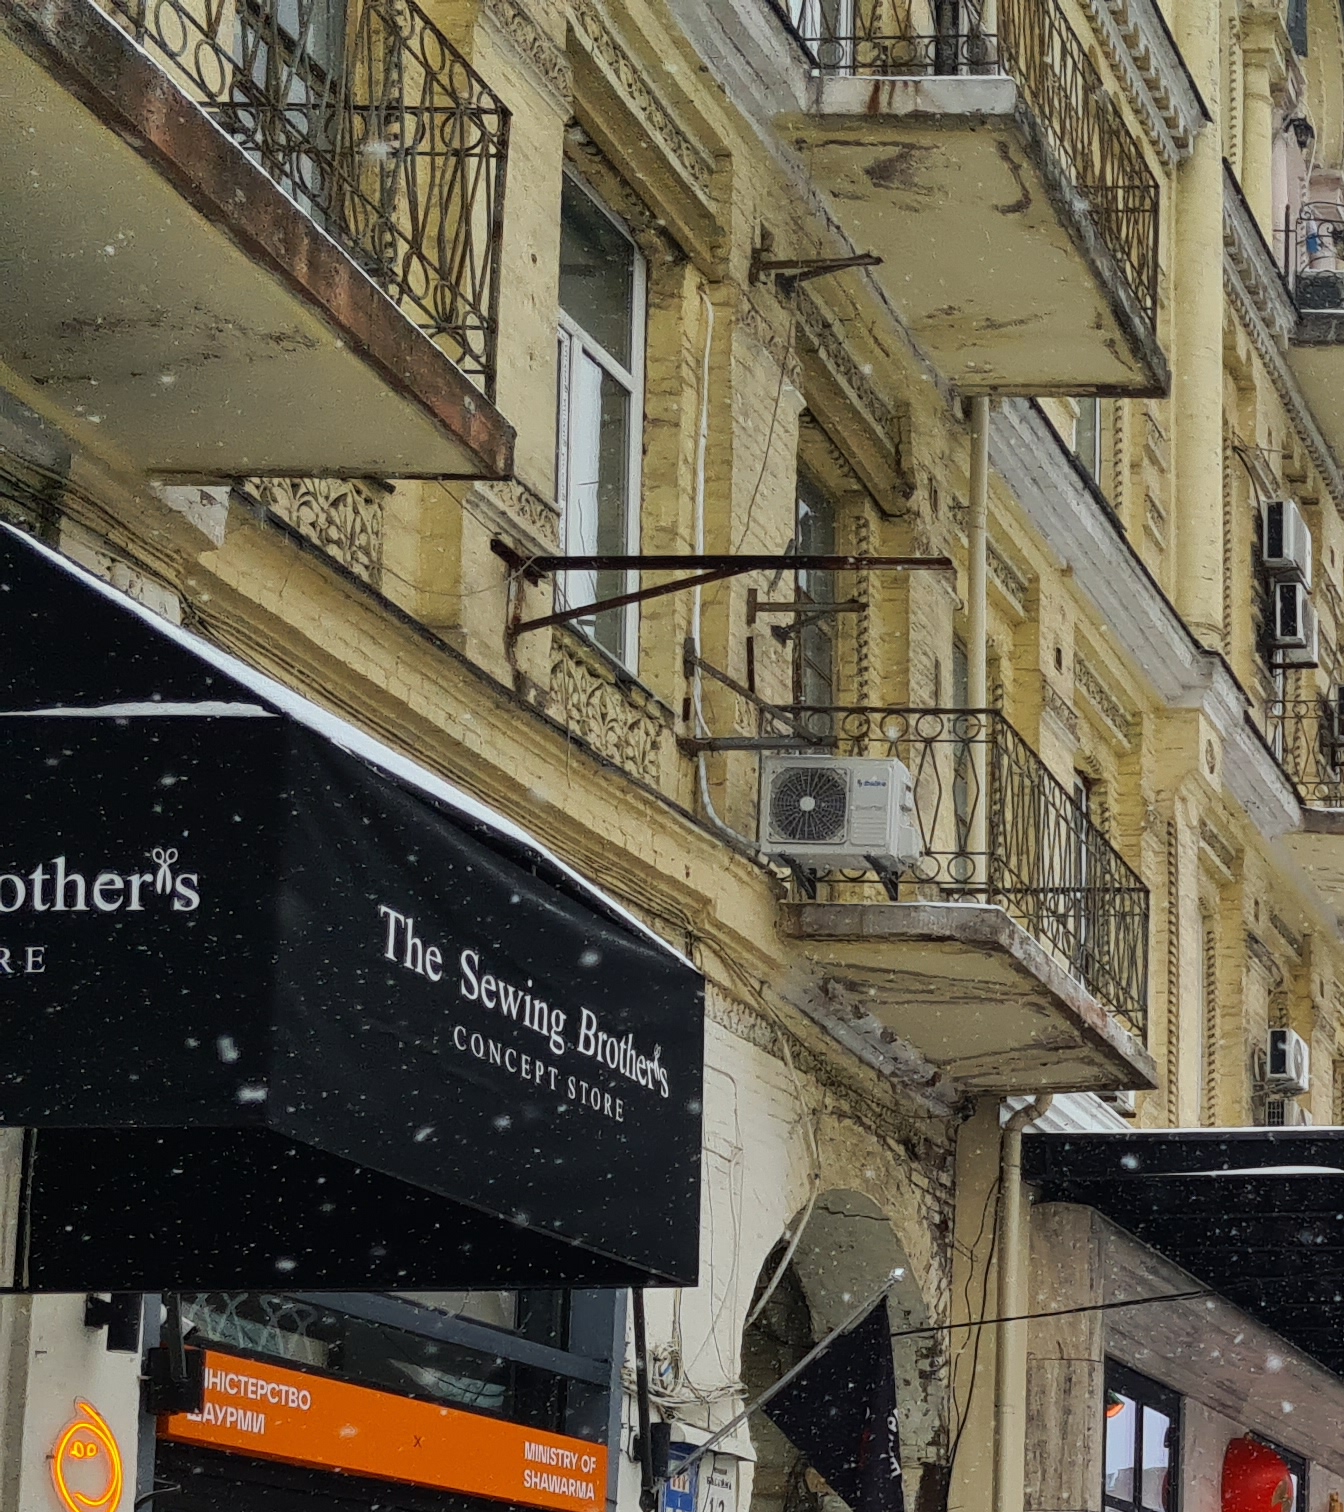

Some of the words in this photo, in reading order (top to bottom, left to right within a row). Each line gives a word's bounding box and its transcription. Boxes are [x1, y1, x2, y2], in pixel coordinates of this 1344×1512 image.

[378, 904, 442, 982] The
[460, 949, 567, 1055] Sewing
[454, 1025, 558, 1090] CONCEPT
[568, 1076, 624, 1123] STORE
[204, 1367, 311, 1410] ІНІСТЕРСТВО
[524, 1441, 579, 1470] MINISTRY
[581, 1455, 597, 1474] OF
[523, 1470, 595, 1501] SHAWARMA
